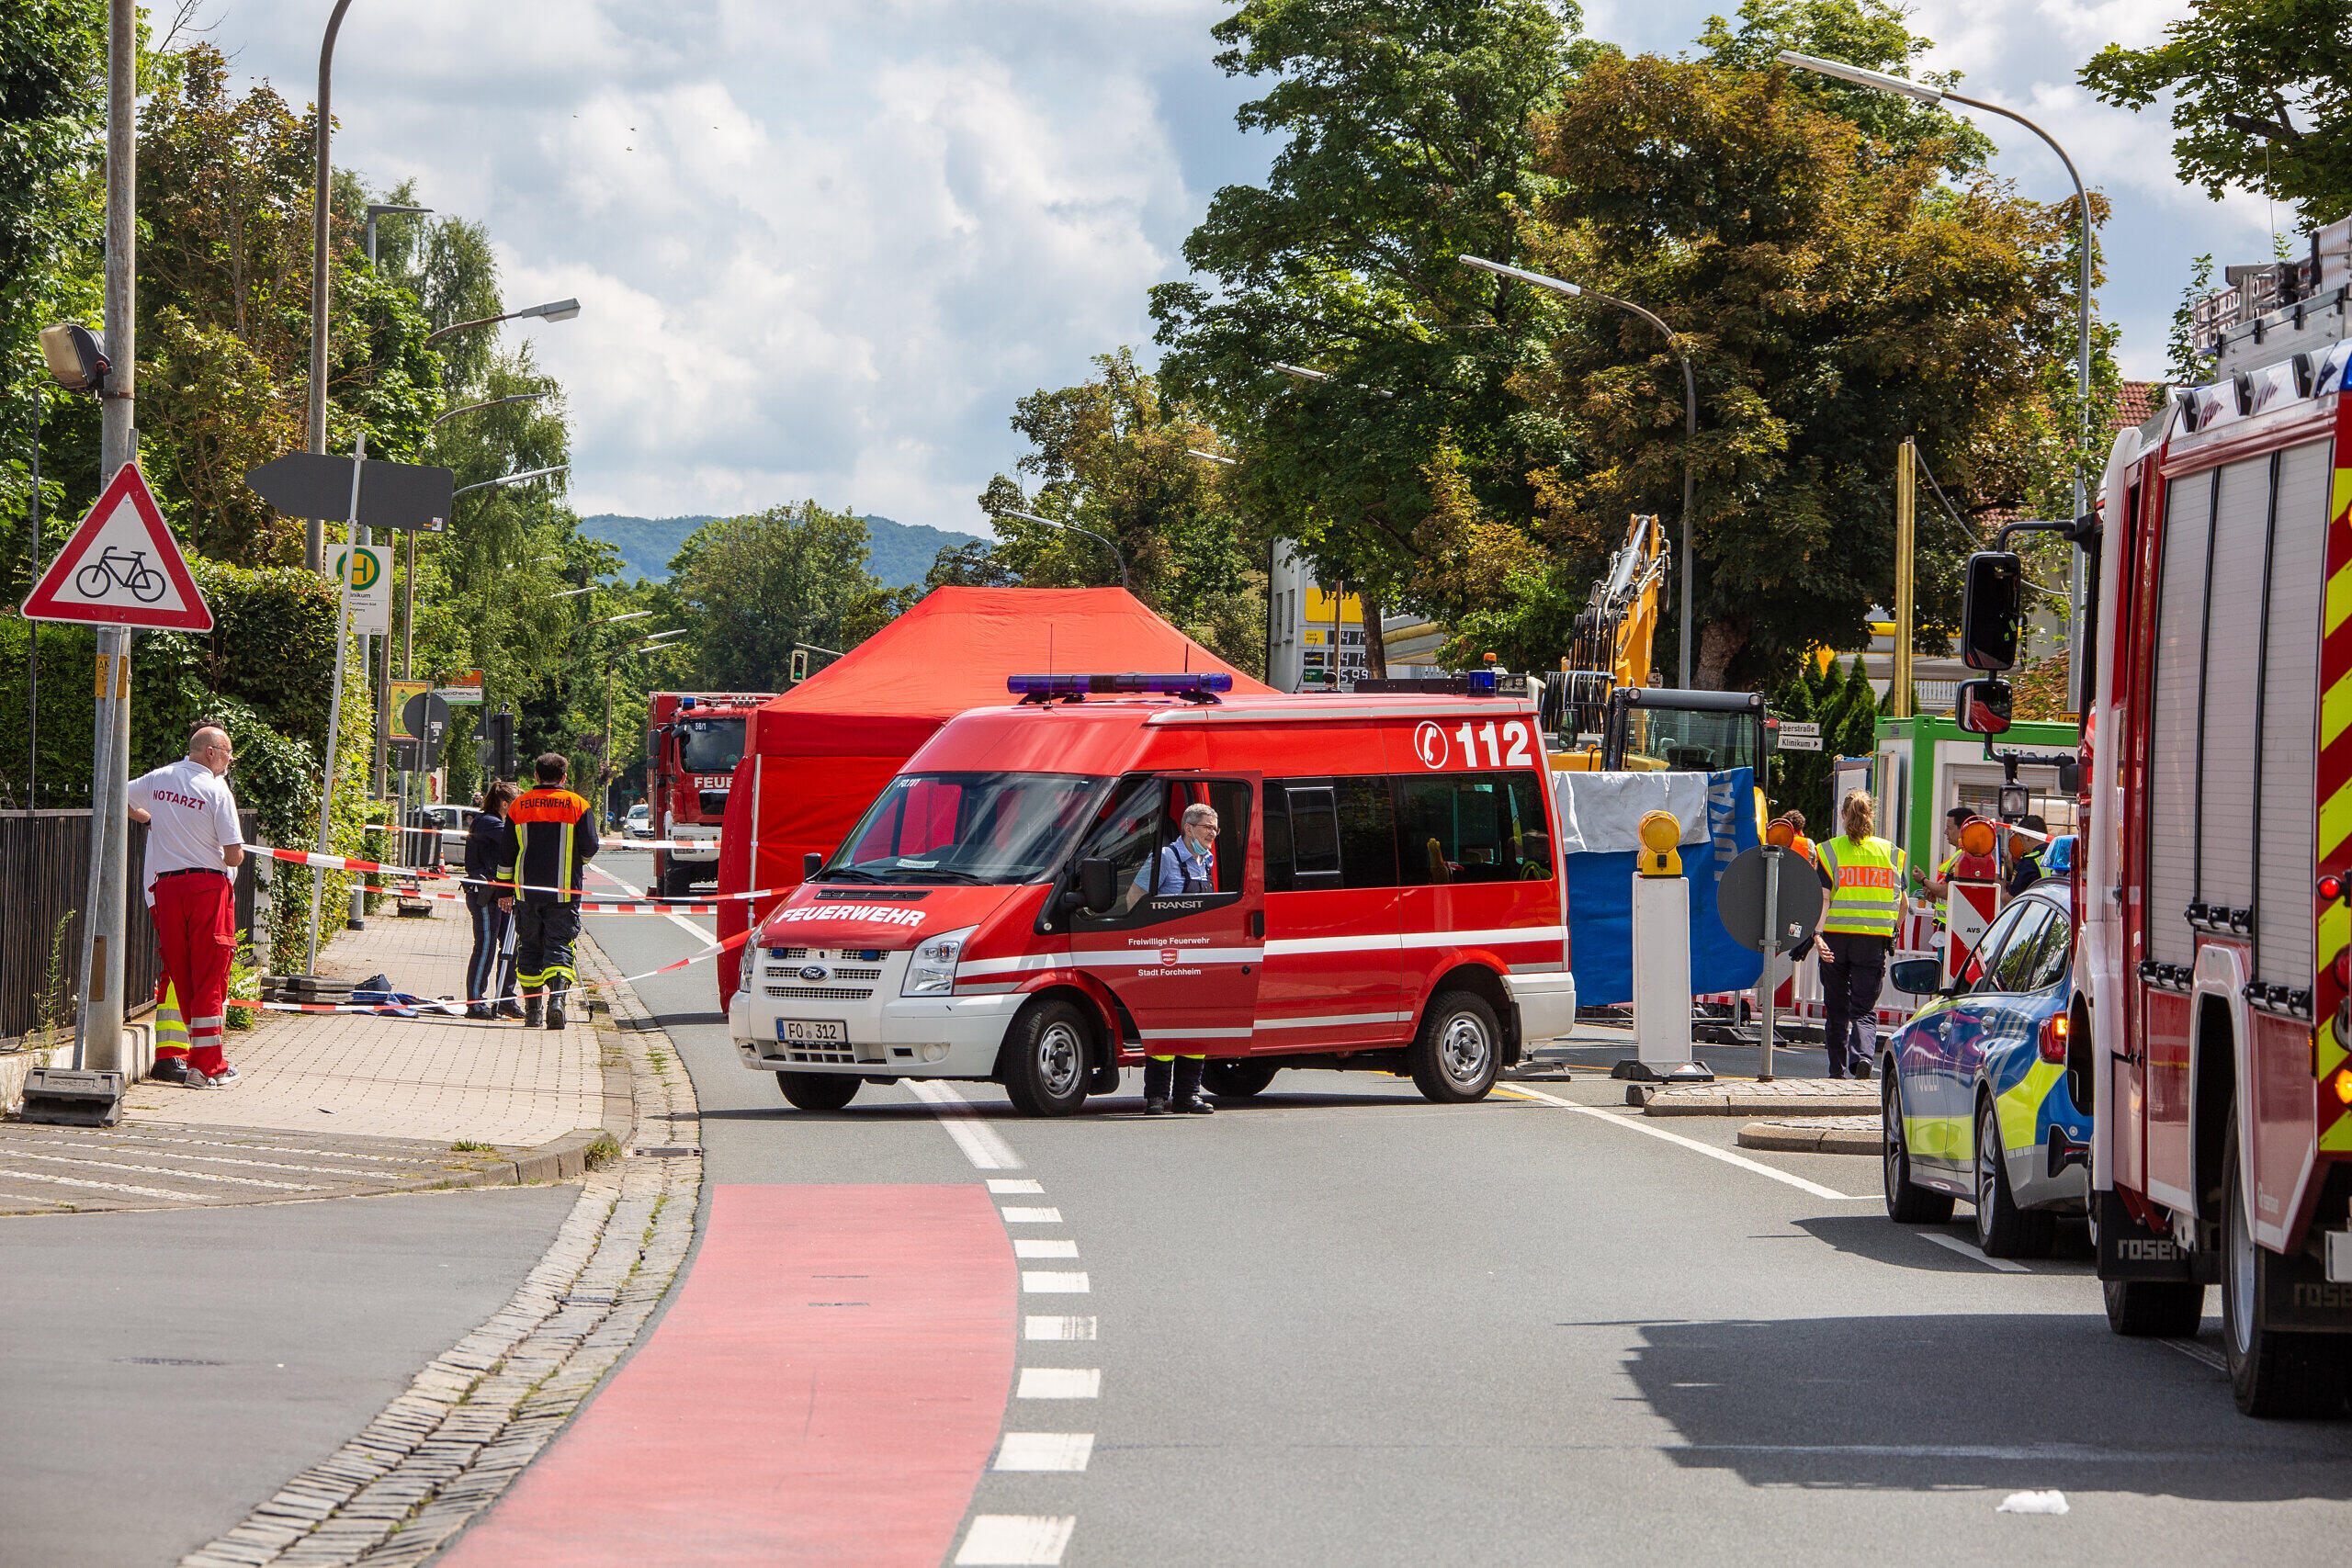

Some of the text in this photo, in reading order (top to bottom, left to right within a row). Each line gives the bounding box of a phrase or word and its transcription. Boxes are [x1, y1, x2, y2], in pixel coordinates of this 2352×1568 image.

[1455, 720, 1533, 768] 112
[1781, 738, 1811, 748] Klinikum
[153, 790, 206, 810] NOTARZT
[520, 797, 571, 810] FEUERWEHR
[1838, 867, 1893, 887] POLIZEI
[1150, 901, 1203, 909] TRANSIT
[774, 905, 926, 927] FEUERWEHR
[1128, 937, 1210, 947] Freiwillige Feuerwehr
[803, 967, 821, 978] Ford
[1137, 967, 1202, 976] Stadt Forchheim
[788, 1023, 837, 1039] FO 312
